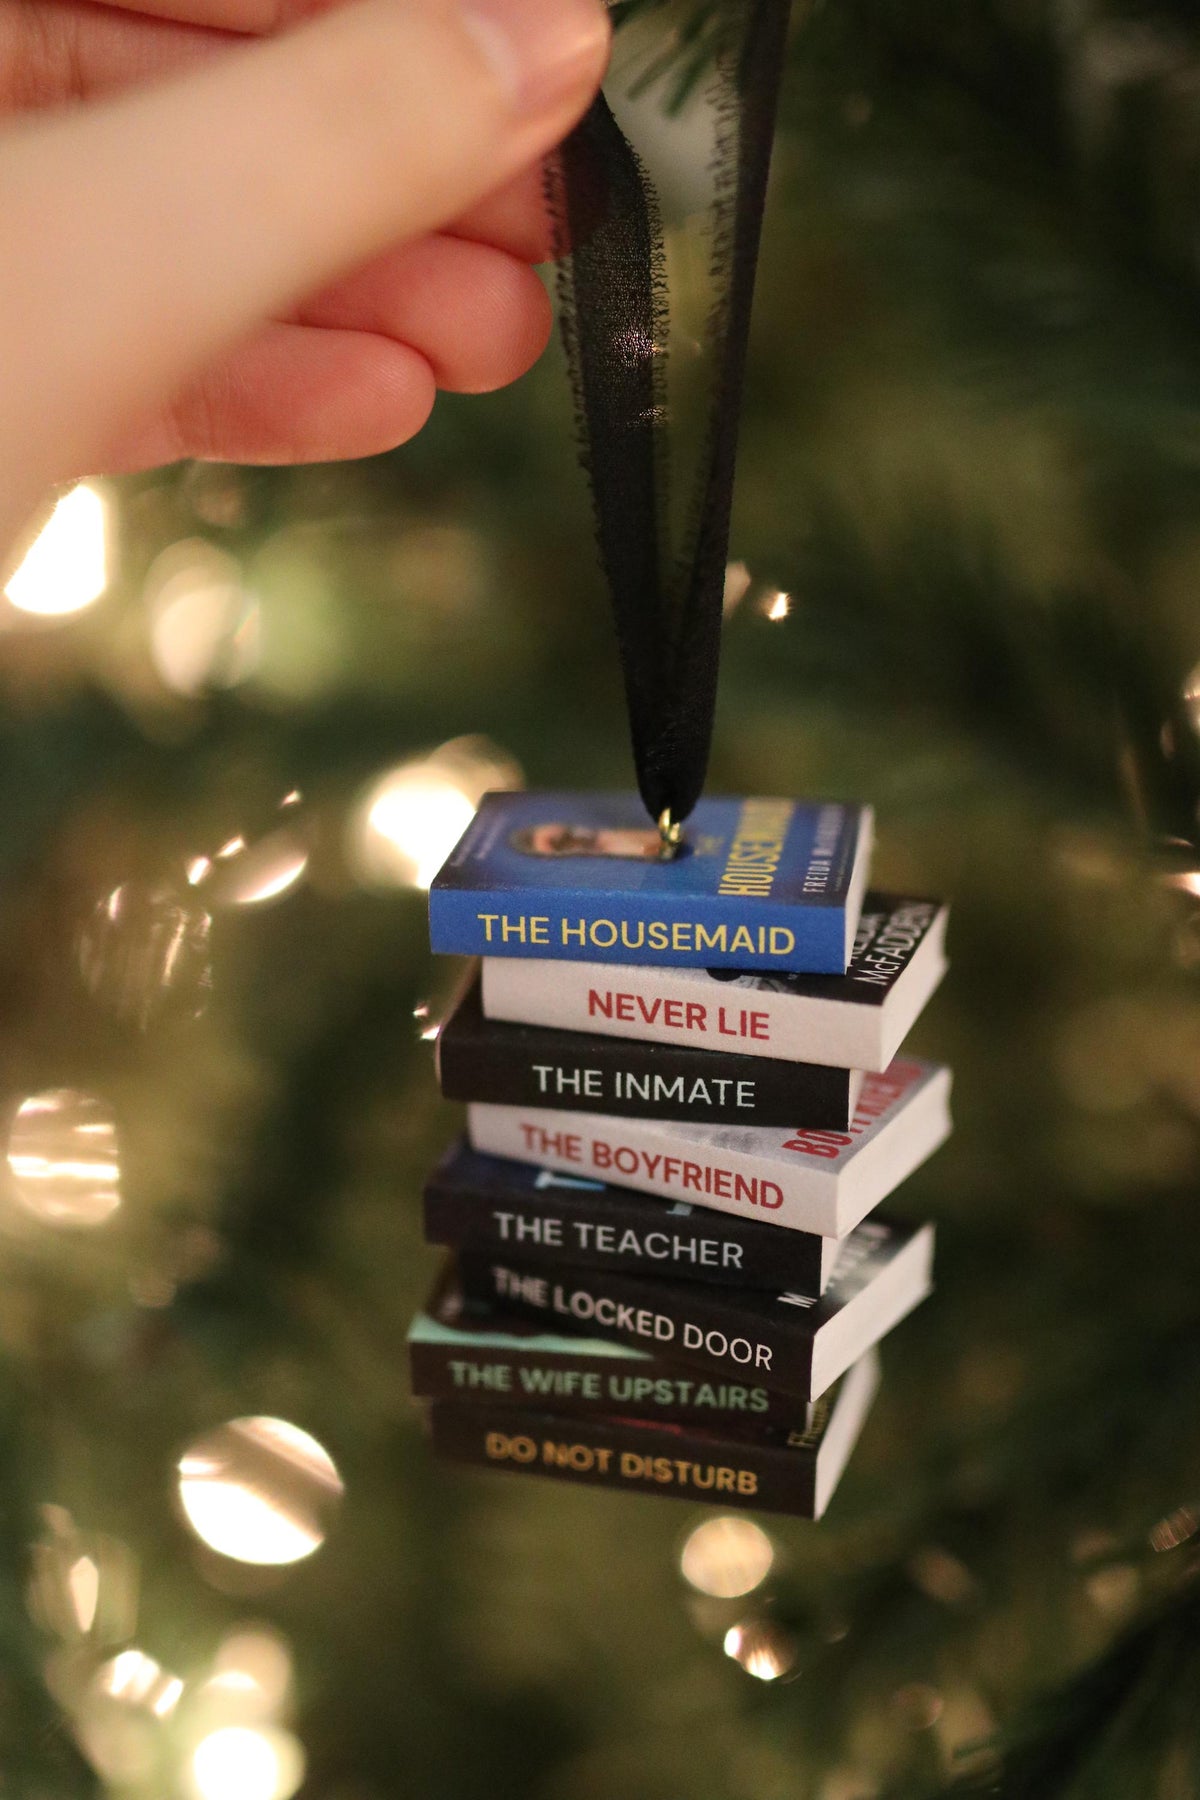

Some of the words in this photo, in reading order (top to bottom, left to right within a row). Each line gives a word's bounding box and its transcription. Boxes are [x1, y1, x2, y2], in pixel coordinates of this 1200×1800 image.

[477, 913, 550, 945] THE
[561, 917, 796, 956] HOUSEMAID
[588, 988, 708, 1032] NEVER
[718, 1006, 770, 1041] LIE
[532, 1065, 604, 1098] THE
[615, 1071, 756, 1108] INMATE
[519, 1122, 583, 1163] THE
[592, 1140, 785, 1210] BOYFRIEND
[493, 1211, 564, 1247] THE
[573, 1222, 744, 1269] TEACHER
[491, 1266, 549, 1308] THE
[554, 1284, 675, 1341] LOCKED
[683, 1322, 773, 1371] DOOR
[449, 1360, 513, 1393] THE
[520, 1365, 602, 1401] WIFE
[608, 1375, 770, 1413] UPSTAIRS
[484, 1431, 538, 1464] DO
[543, 1440, 613, 1474] NOT
[620, 1451, 759, 1495] DISTURB
